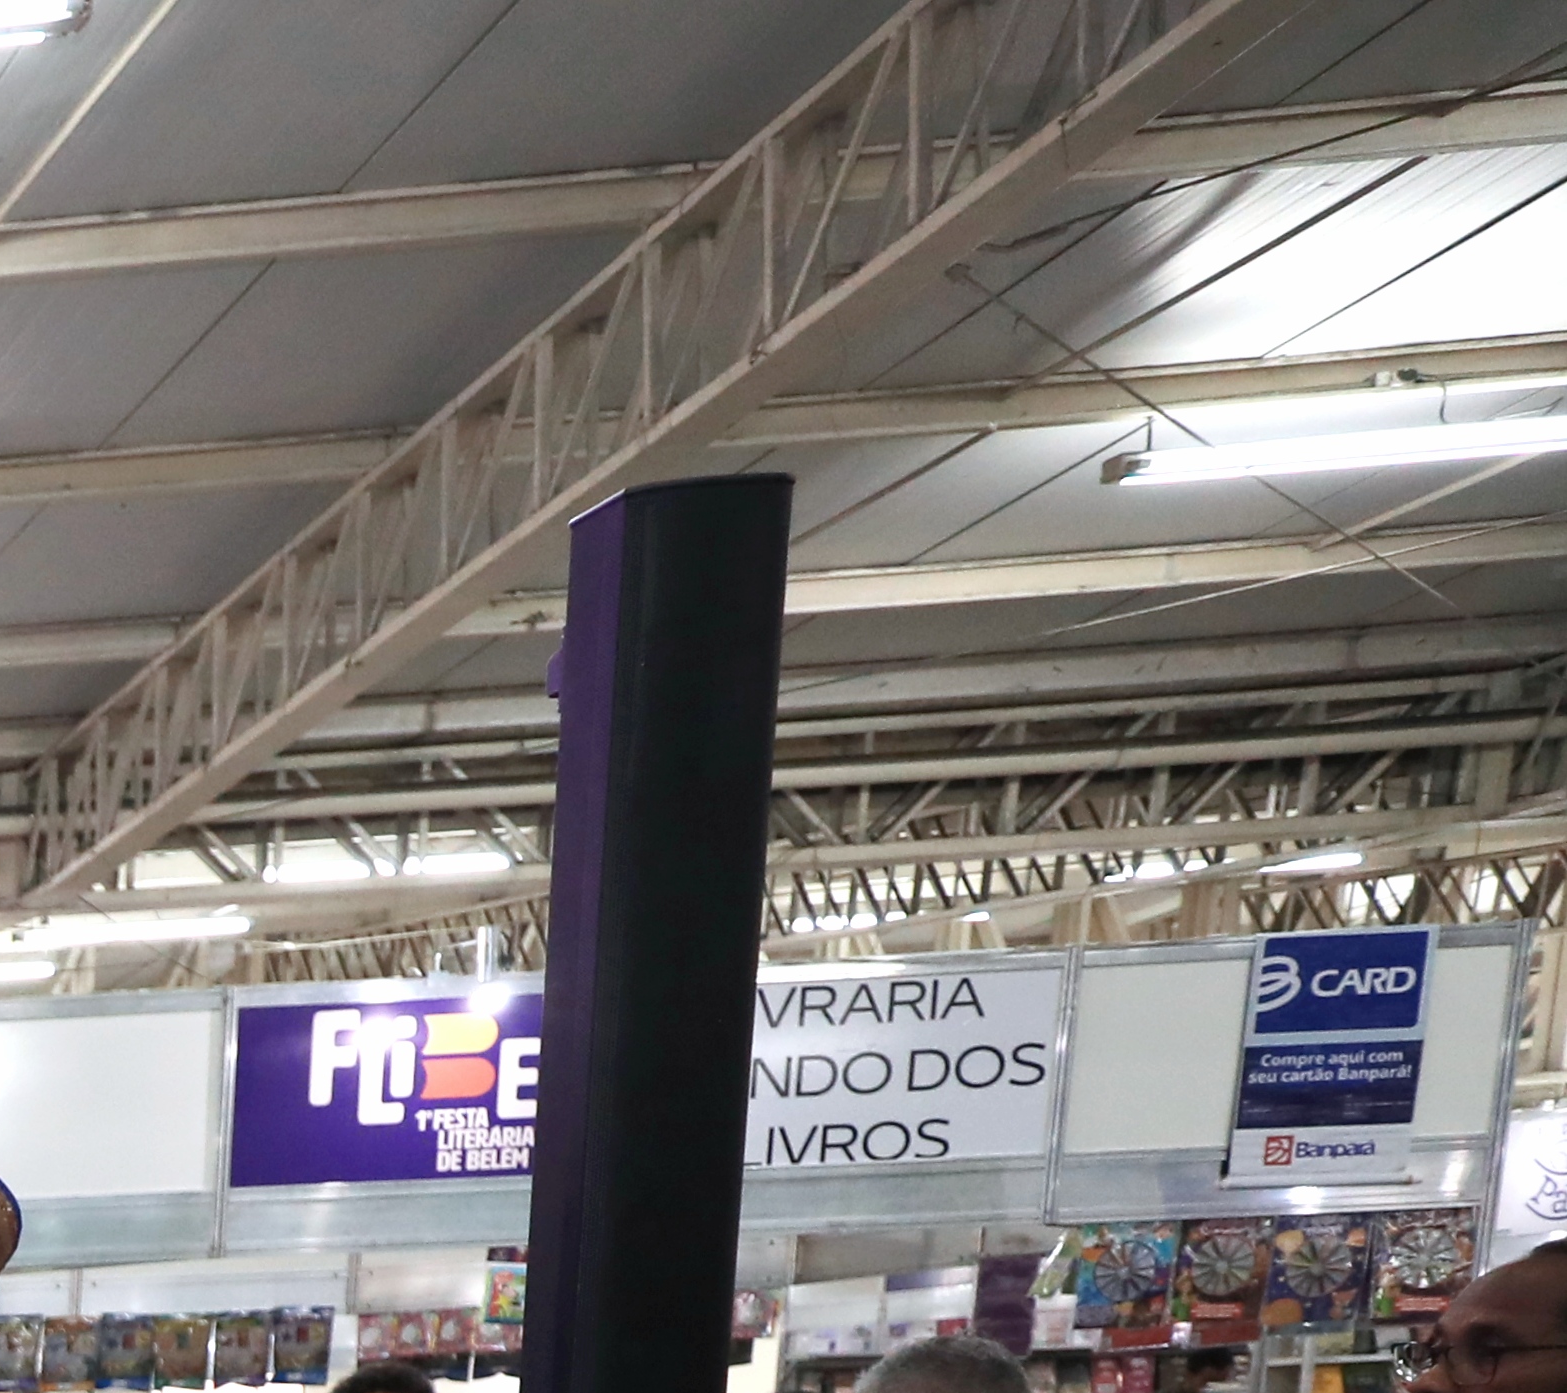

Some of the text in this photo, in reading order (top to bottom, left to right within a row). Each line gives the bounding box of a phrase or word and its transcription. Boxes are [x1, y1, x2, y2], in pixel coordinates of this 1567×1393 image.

[1310, 965, 1417, 998] CARD
[757, 977, 985, 1029] VRARIA
[1260, 1050, 1404, 1068] Compre aqui com
[749, 1042, 1047, 1099] NDO DOS
[1248, 1065, 1413, 1084] seu cartão Banpará!
[432, 1107, 490, 1131] FESTA
[1295, 1140, 1376, 1159] Banpará
[436, 1152, 463, 1172] DE
